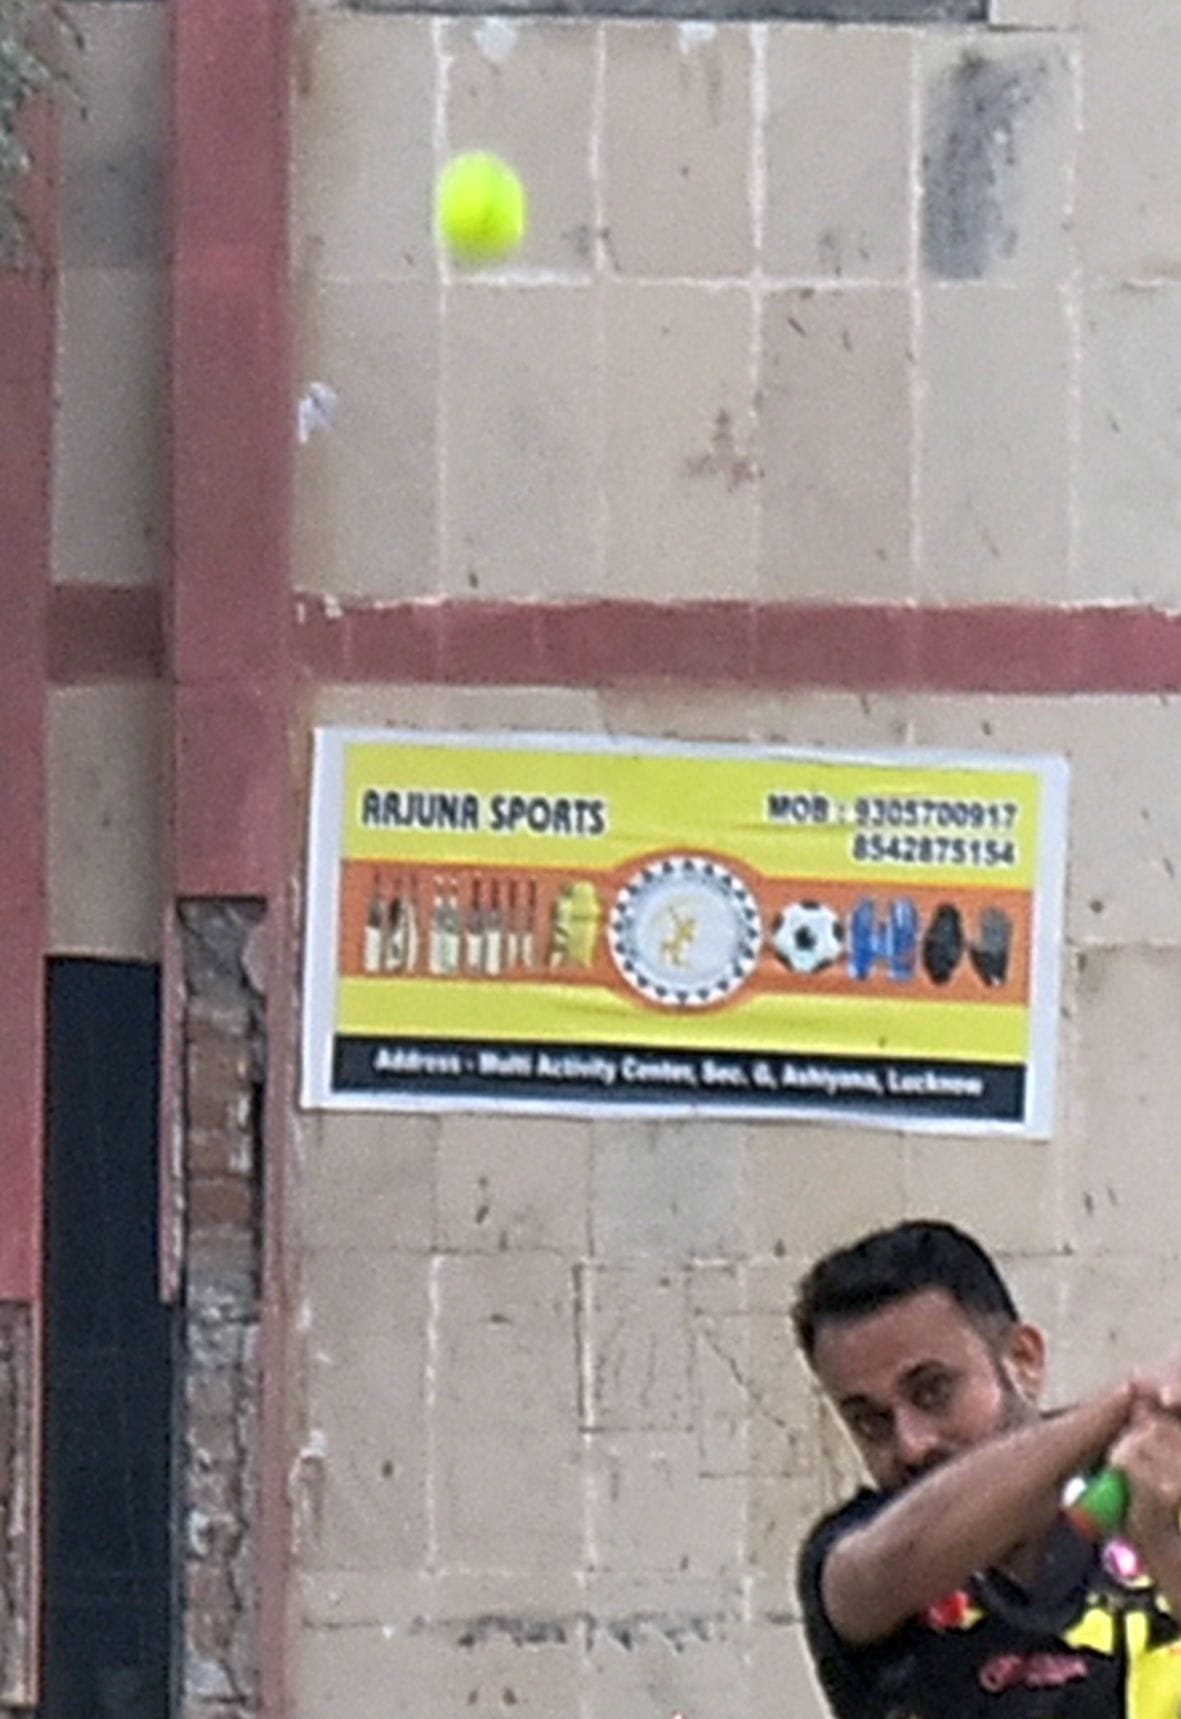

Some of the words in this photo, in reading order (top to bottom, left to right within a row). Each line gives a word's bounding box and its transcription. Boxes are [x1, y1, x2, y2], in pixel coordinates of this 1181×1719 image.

[362, 789, 478, 829] ARJUNA
[490, 795, 605, 836] SPORTS
[767, 794, 829, 822] MOB
[852, 834, 1015, 865] 8542875154
[374, 1047, 460, 1074] Address
[537, 1053, 616, 1085] Activity
